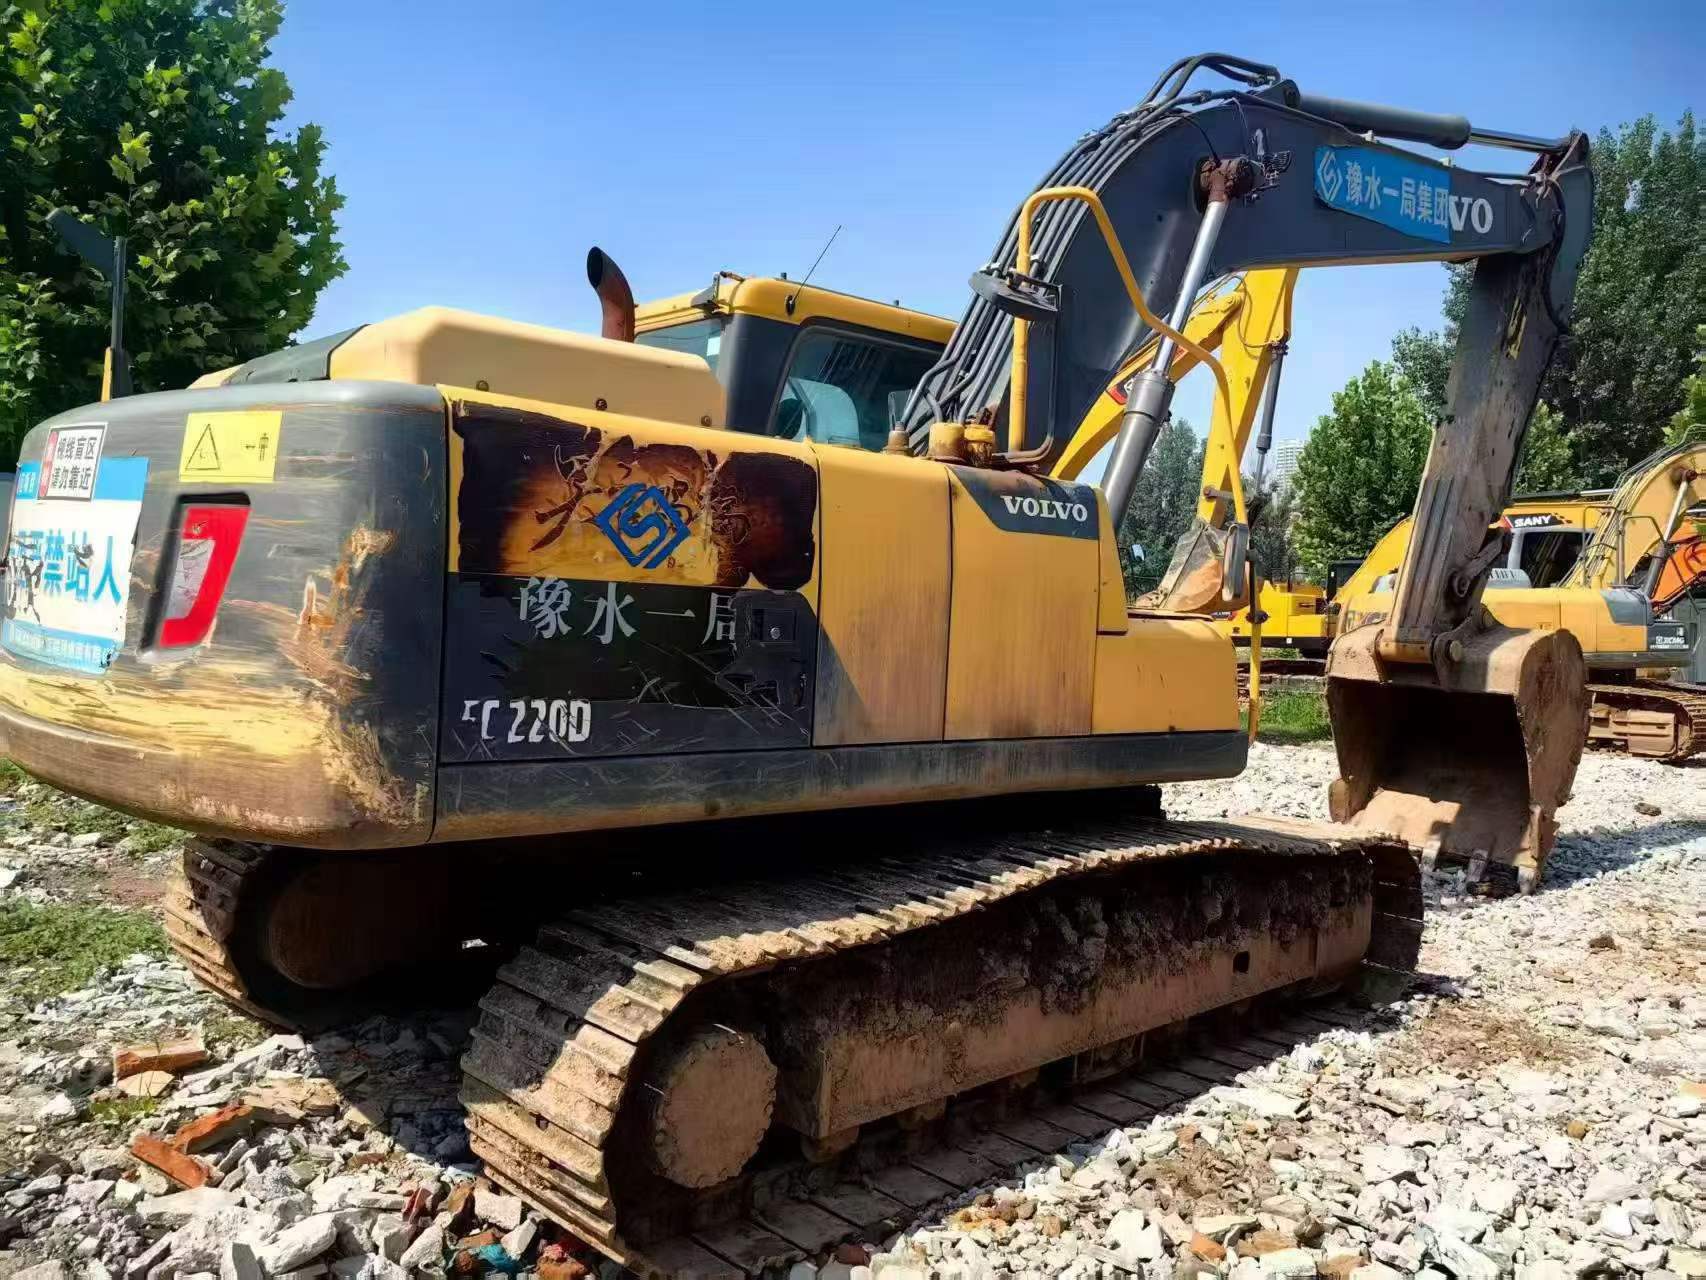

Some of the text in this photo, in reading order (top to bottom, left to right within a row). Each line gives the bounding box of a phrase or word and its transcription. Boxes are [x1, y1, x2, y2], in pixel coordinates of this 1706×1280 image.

[1346, 160, 1449, 228] 豫水一局集团
[1000, 495, 1088, 522] VOLVO
[1514, 515, 1551, 528] SANY
[9, 528, 122, 605] 禁站人
